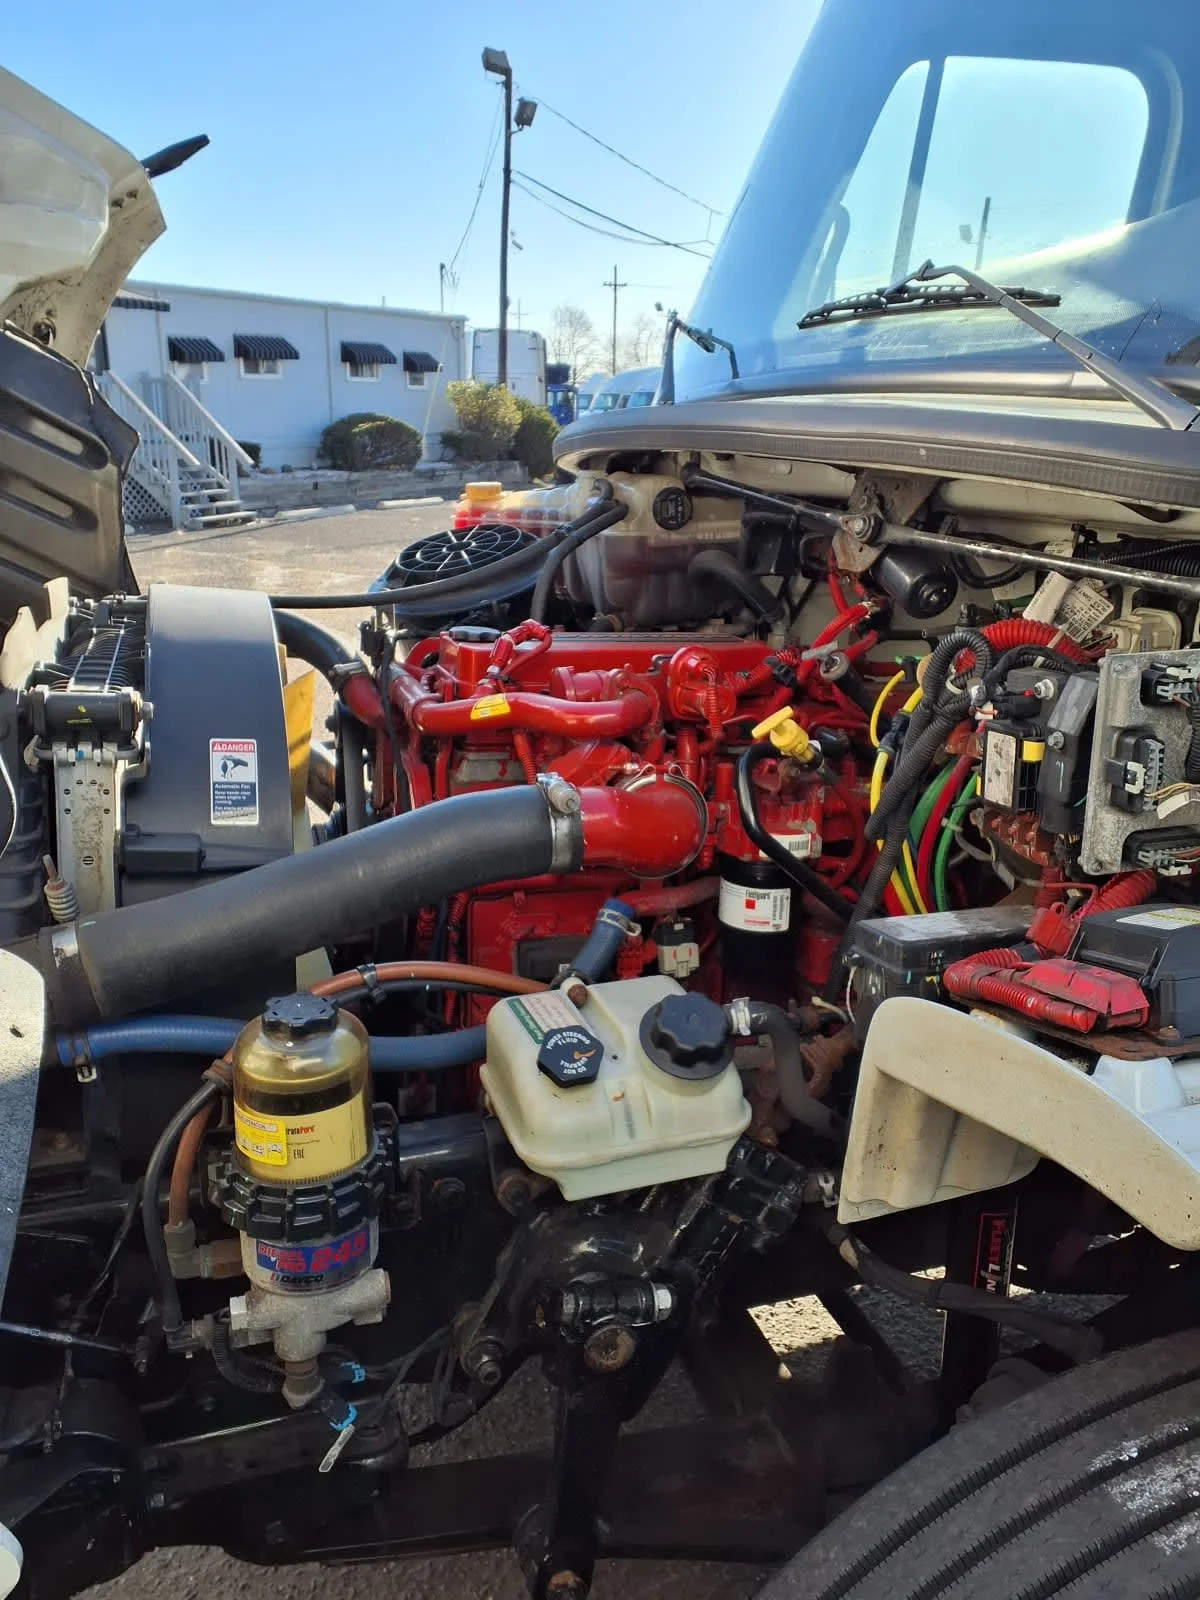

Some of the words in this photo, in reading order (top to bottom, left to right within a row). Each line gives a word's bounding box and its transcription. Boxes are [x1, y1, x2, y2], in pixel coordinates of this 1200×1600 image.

[221, 743, 254, 752] DANGER
[546, 1033, 562, 1049] POWER
[562, 1031, 590, 1045] STEERING
[557, 1037, 578, 1046] FLUID
[258, 1243, 304, 1260] DIESEL
[985, 1219, 1005, 1295] FLEETLIN
[280, 1273, 324, 1285] DAVCO
